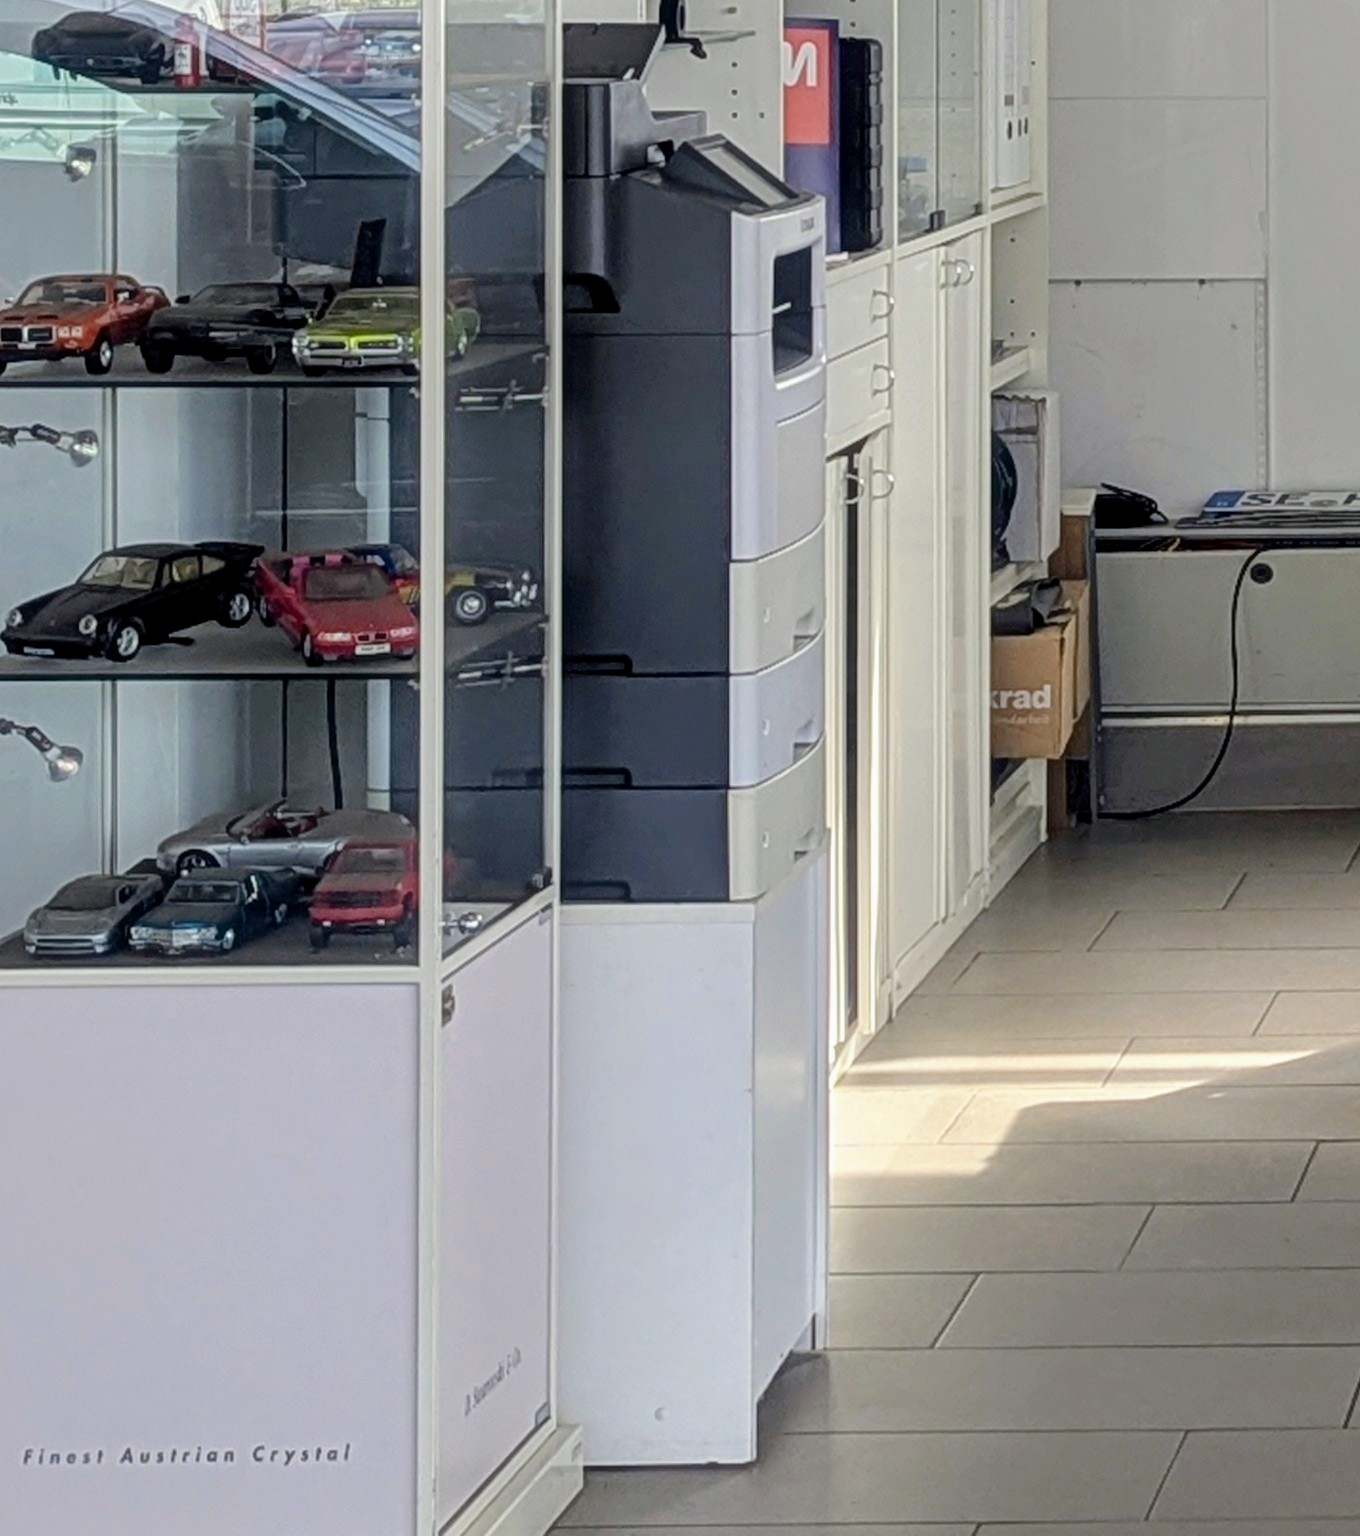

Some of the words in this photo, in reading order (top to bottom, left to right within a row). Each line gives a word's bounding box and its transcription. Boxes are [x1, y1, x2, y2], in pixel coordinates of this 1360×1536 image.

[1241, 492, 1308, 507] SE
[23, 1448, 103, 1464] Finest
[120, 1447, 235, 1464] Austrian
[252, 1443, 351, 1466] Crystal
